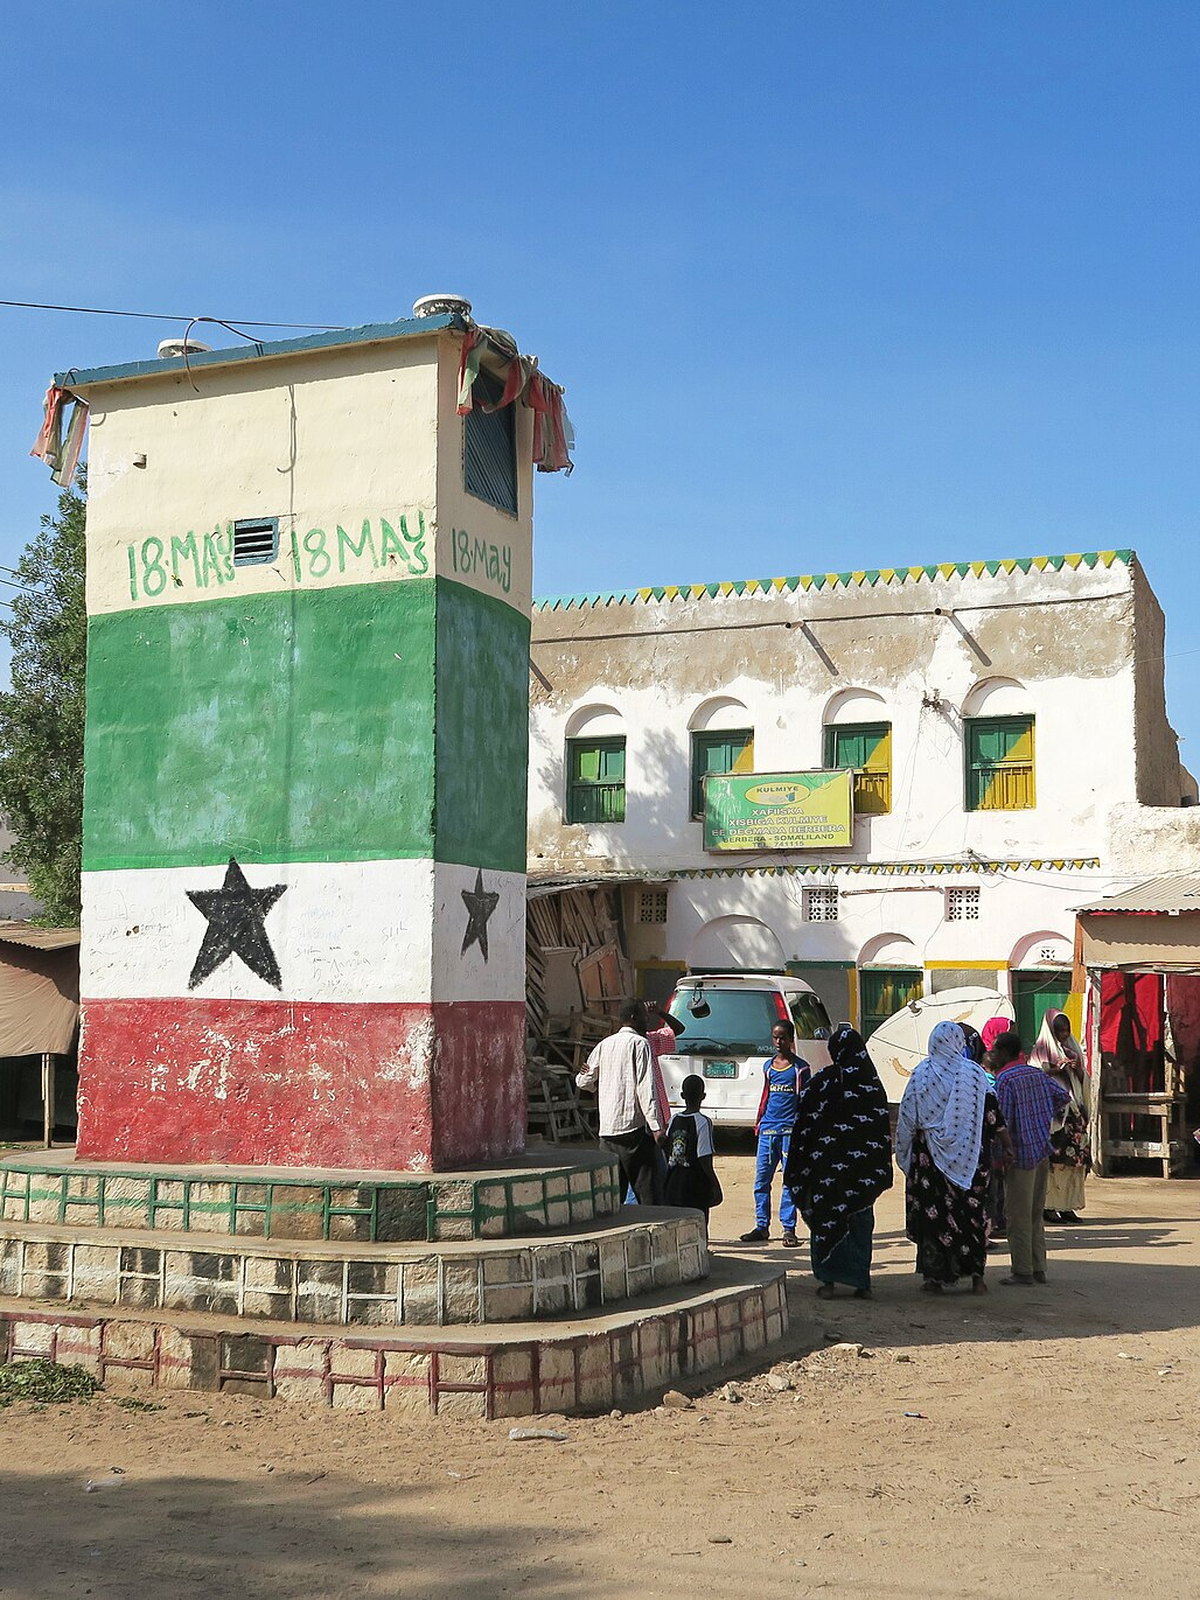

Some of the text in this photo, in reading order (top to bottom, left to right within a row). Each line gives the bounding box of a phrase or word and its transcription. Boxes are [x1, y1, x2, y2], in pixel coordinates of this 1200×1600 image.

[291, 527, 331, 583] 18
[756, 785, 800, 794] KULMIYE
[751, 806, 804, 817] XAFIISKA
[728, 815, 828, 827] XISBIGA KULMIYE
[711, 824, 846, 837] EE DEGMADA BERBERA
[774, 833, 835, 842] SOMALILAND
